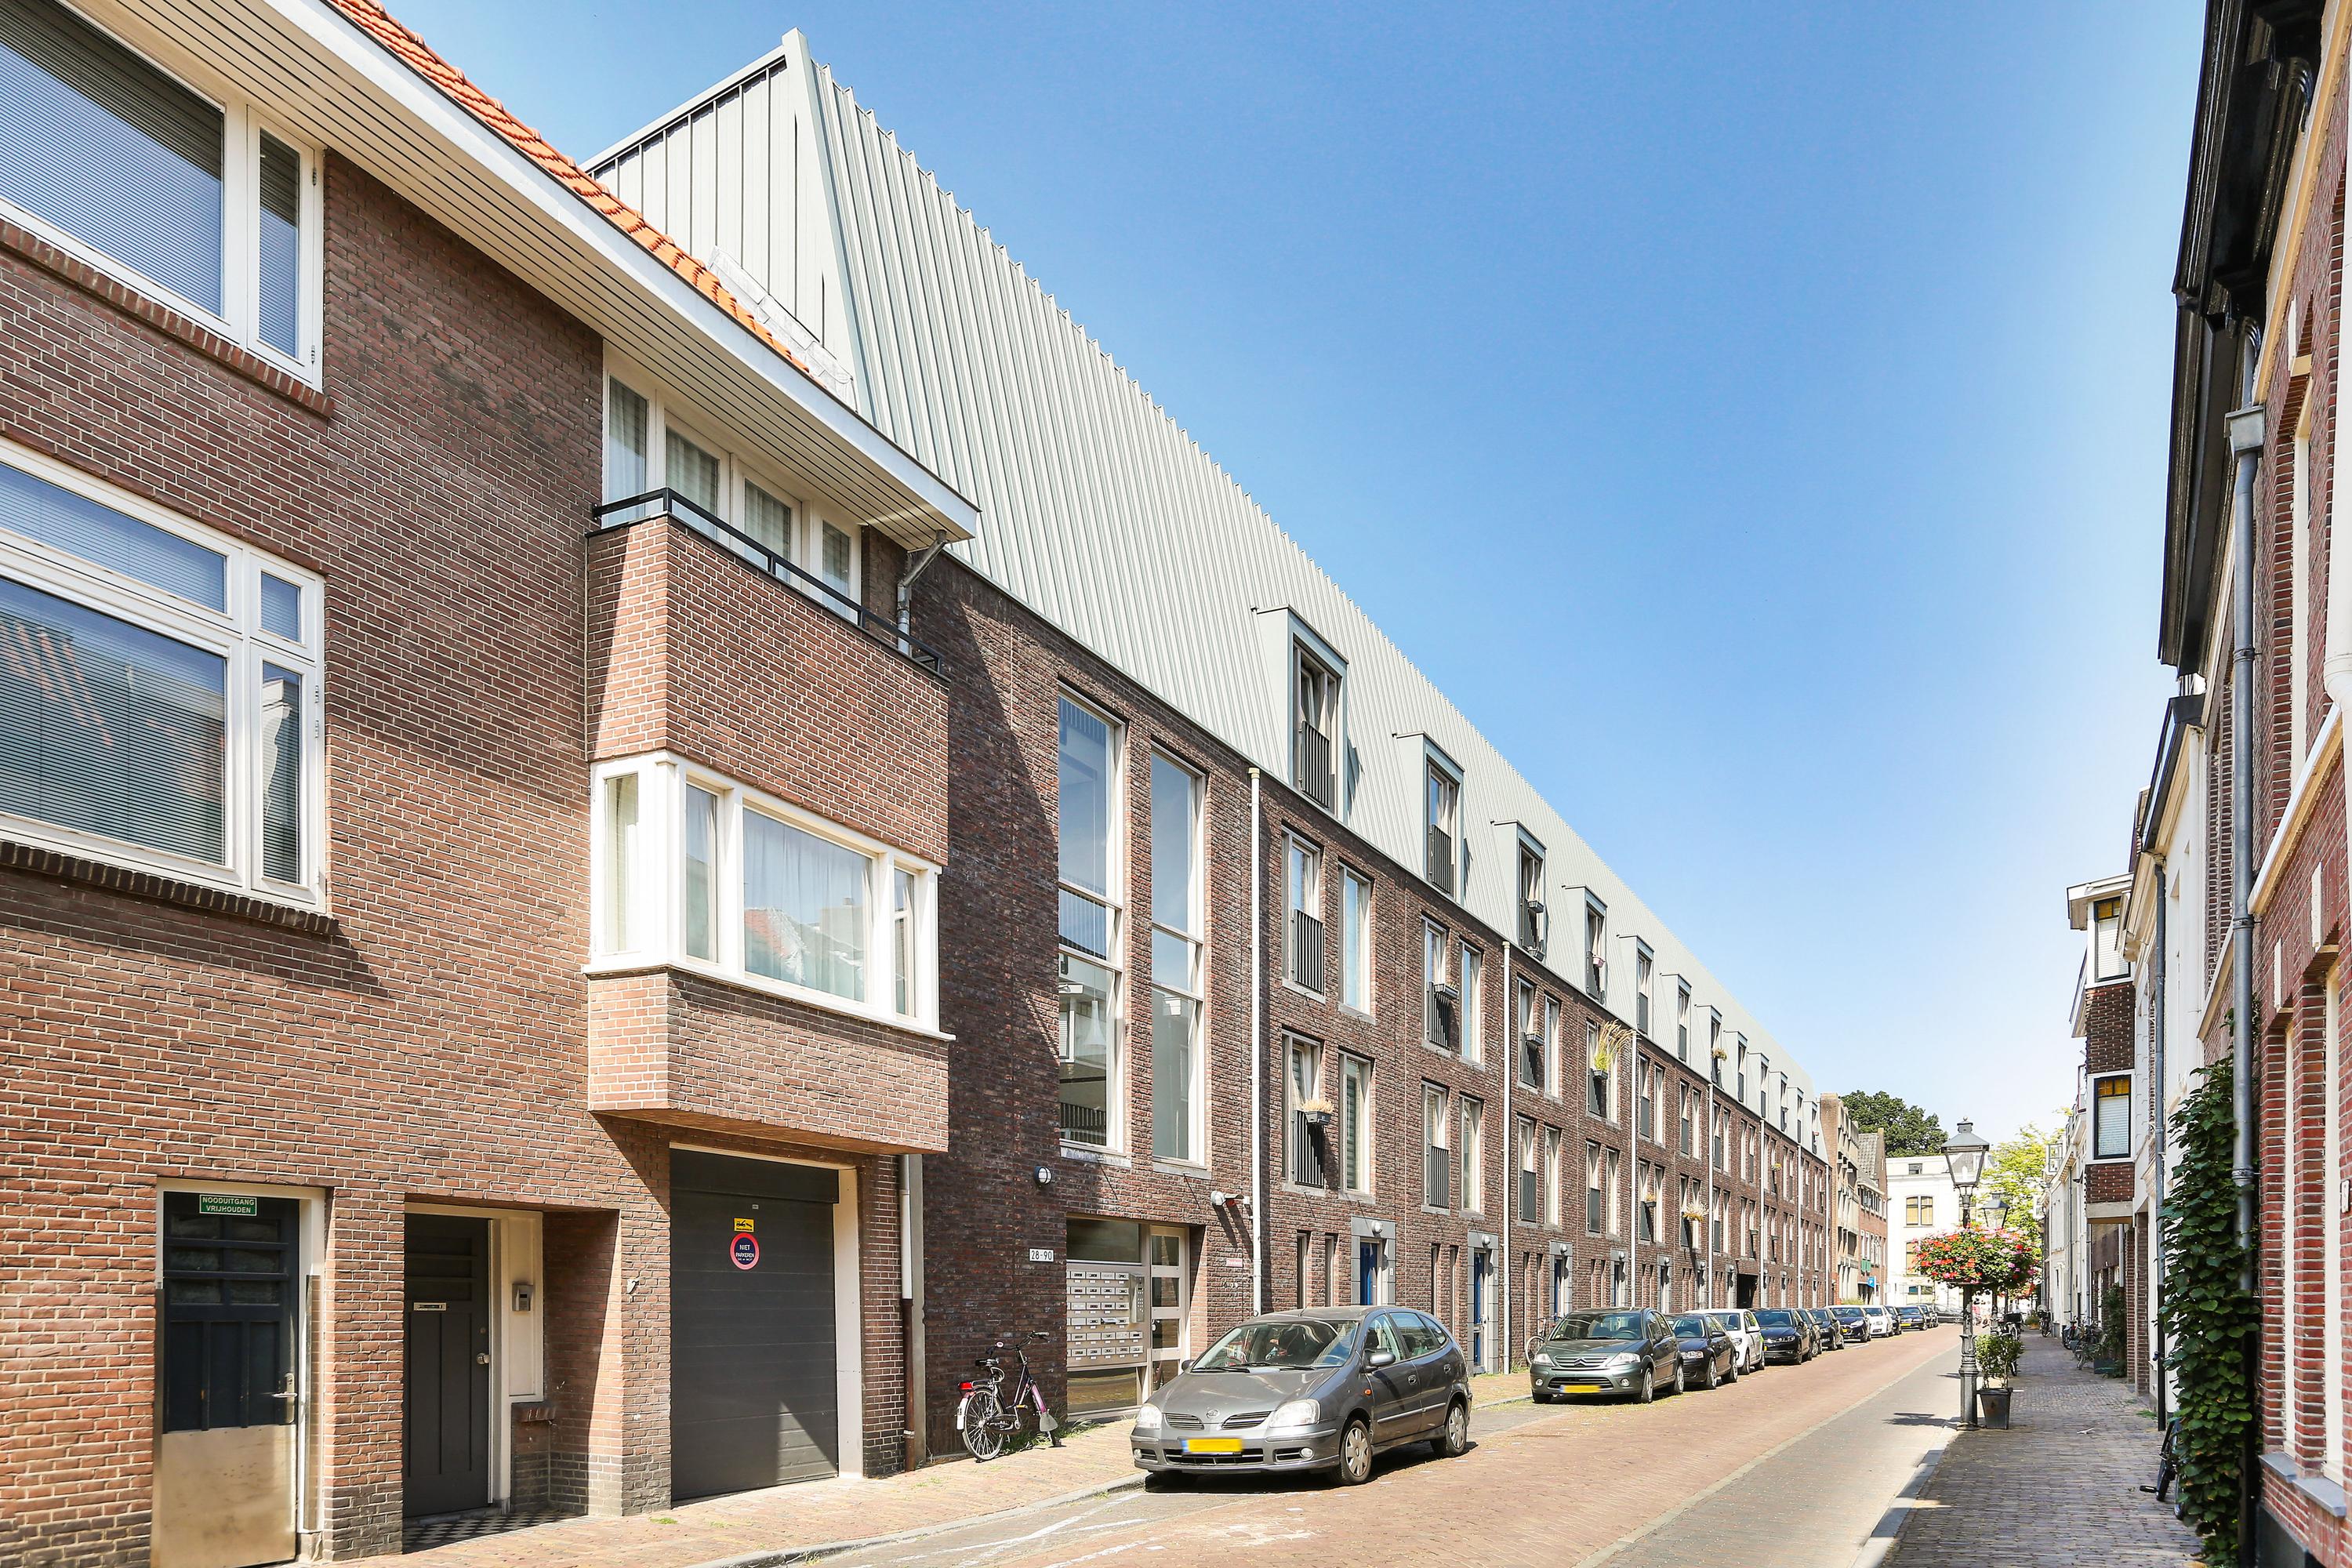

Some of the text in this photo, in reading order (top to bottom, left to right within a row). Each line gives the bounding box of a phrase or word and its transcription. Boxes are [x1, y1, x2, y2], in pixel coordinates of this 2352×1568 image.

[202, 1196, 255, 1206] NOODUITGANG
[205, 1205, 252, 1214] VRIJHOUDEN
[1031, 1250, 1052, 1261] 28-90
